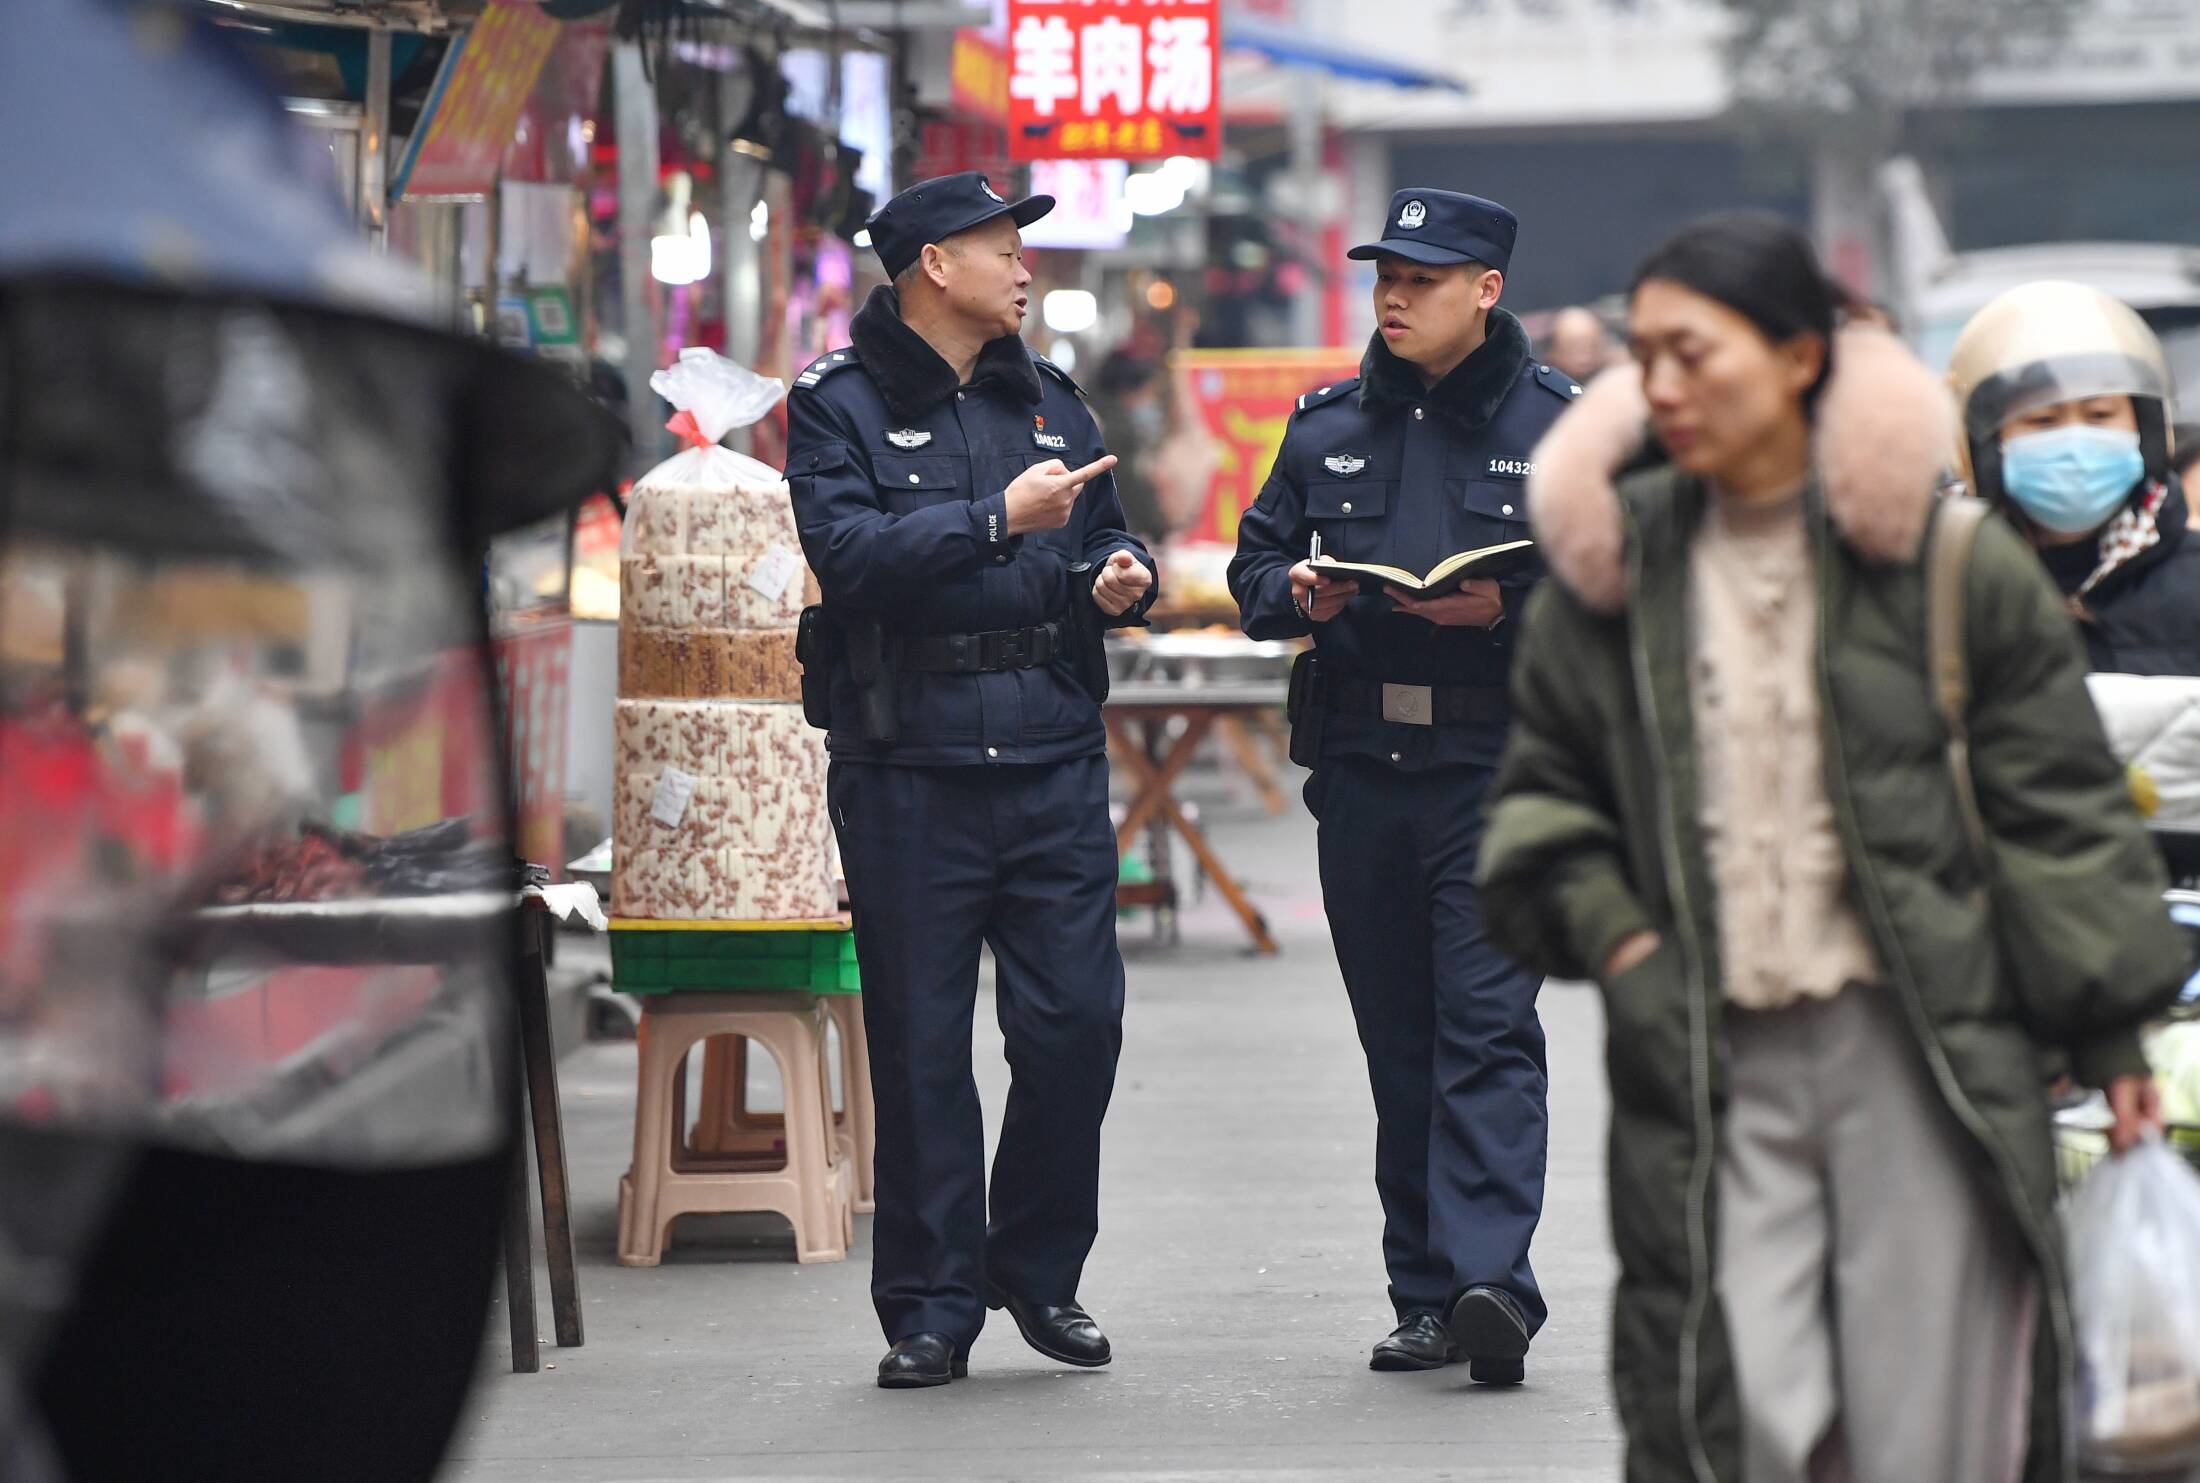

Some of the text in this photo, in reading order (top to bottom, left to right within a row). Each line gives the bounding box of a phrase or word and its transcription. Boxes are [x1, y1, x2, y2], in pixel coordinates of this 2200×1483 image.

[1010, 15, 1213, 116] 羊肉汤
[988, 514, 998, 542] POLICE
